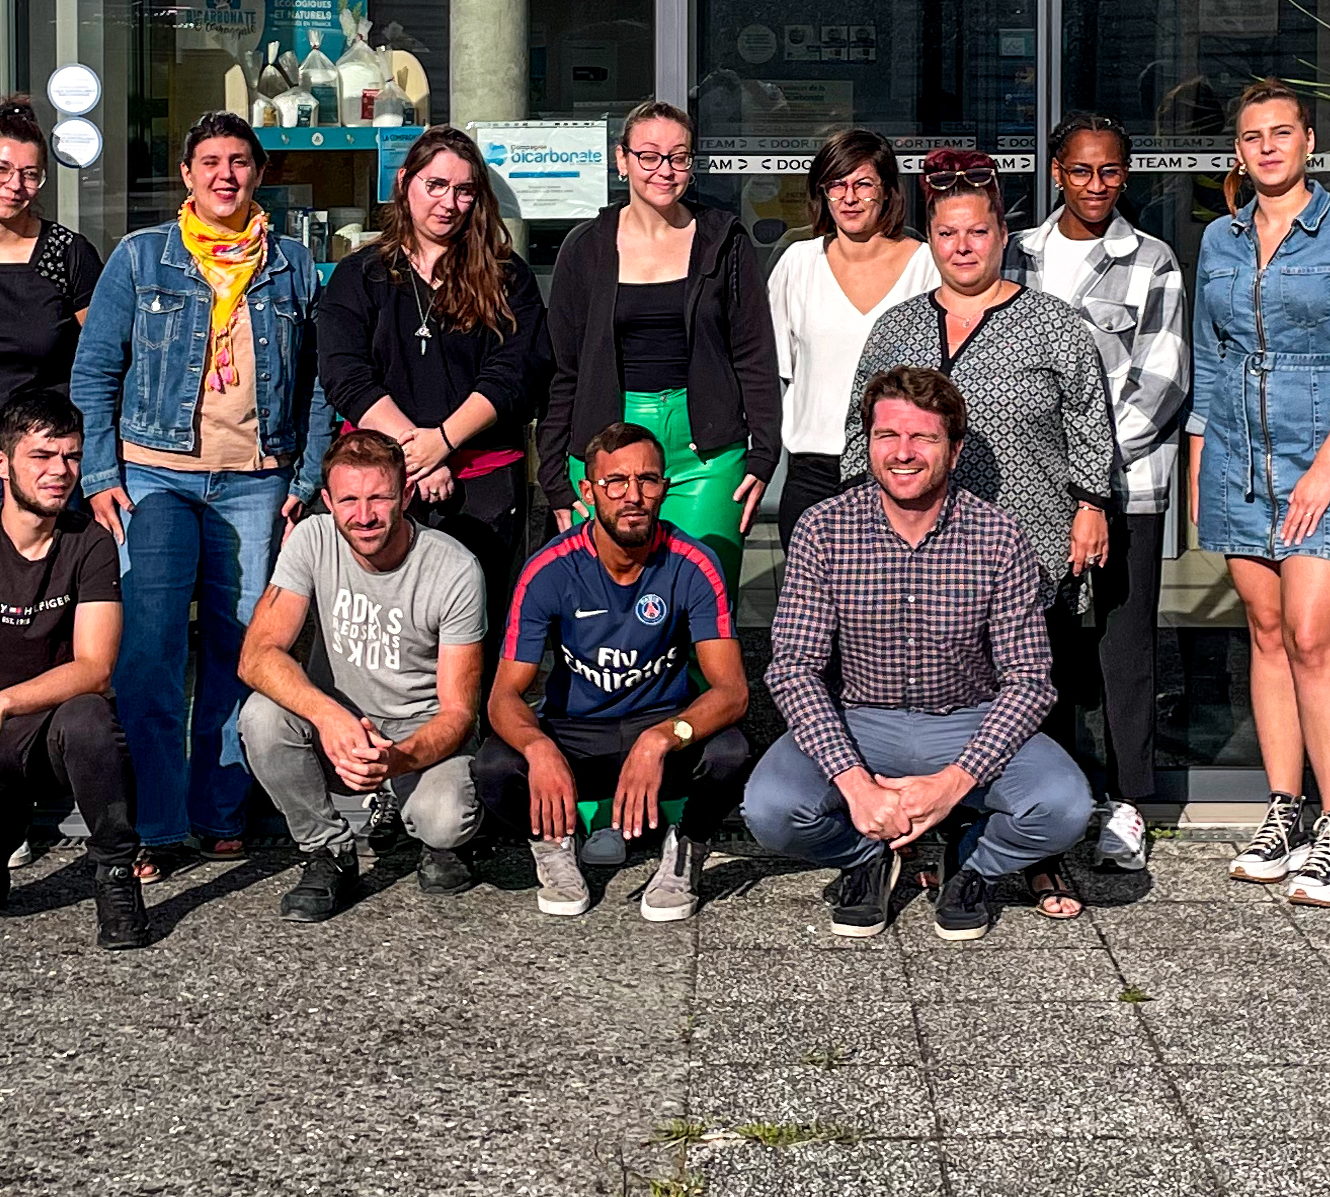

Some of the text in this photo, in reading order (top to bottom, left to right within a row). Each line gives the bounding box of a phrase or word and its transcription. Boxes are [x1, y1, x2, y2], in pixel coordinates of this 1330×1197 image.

[274, 9, 332, 20] ET NATURELS
[699, 139, 735, 148] TEAM
[771, 139, 809, 148] DOOR
[927, 138, 963, 148] TEAM
[1010, 138, 1036, 147] DOO
[1165, 138, 1202, 147] TEAM
[695, 159, 732, 170] EAM
[777, 159, 812, 170] DOO
[1136, 157, 1182, 168] TEAM
[24, 594, 71, 615] HLFIGER
[332, 588, 404, 635] RDKS
